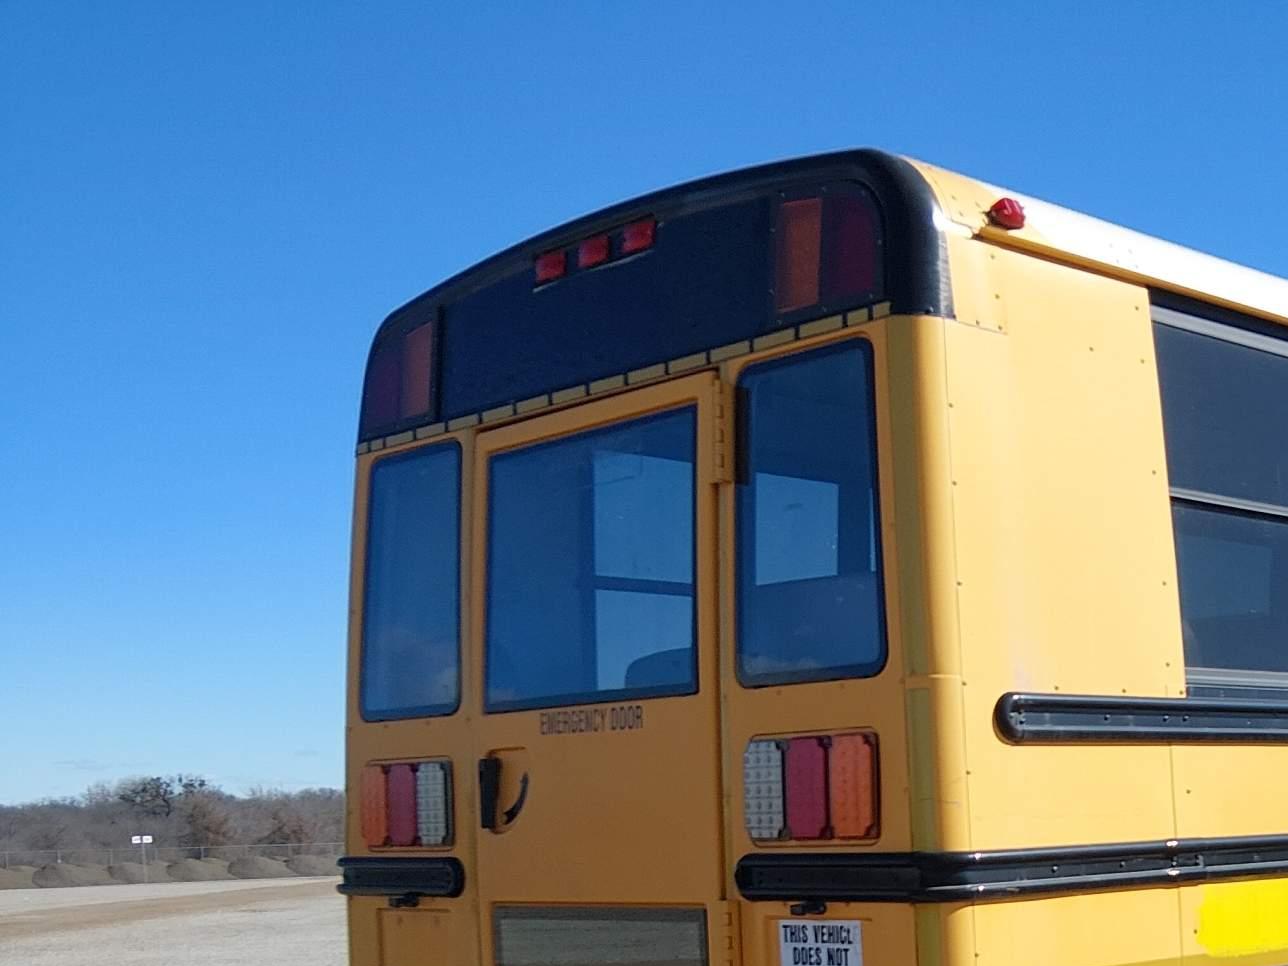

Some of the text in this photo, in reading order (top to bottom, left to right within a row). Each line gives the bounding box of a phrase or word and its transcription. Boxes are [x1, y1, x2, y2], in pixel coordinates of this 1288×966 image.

[540, 705, 643, 735] EMERGENCY DOOR
[782, 924, 808, 943] THIS
[793, 946, 850, 966] DOES NOT
